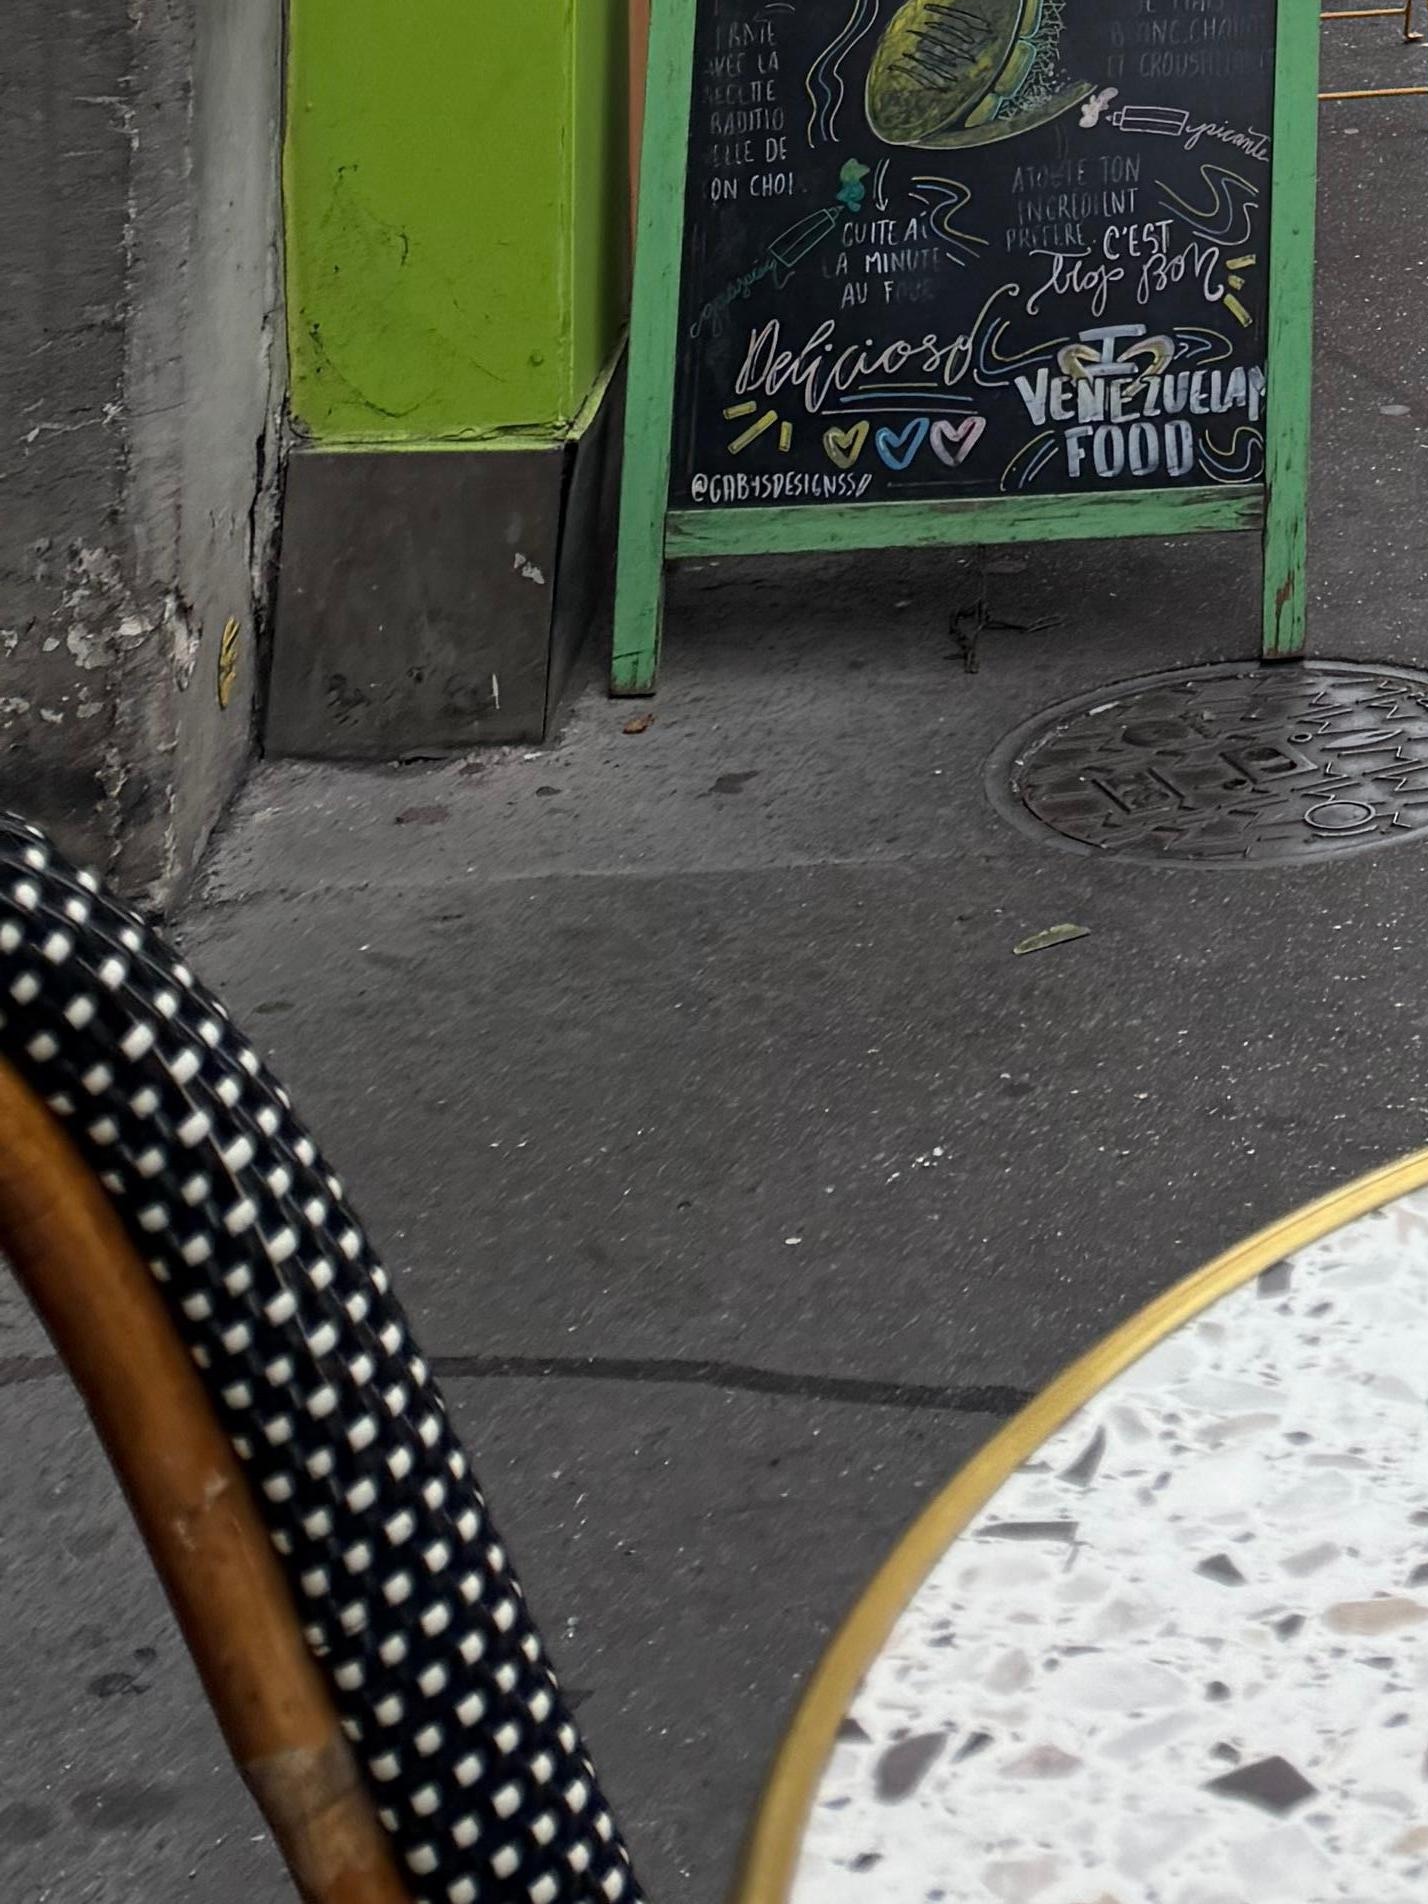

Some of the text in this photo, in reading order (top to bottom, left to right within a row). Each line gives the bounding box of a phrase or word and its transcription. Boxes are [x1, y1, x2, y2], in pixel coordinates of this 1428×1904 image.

[758, 50, 779, 75] LA
[766, 136, 788, 163] DE
[1099, 152, 1141, 184] TON
[1103, 219, 1174, 261] C'EST
[840, 281, 868, 310] AU
[1064, 419, 1194, 478] FOOD
